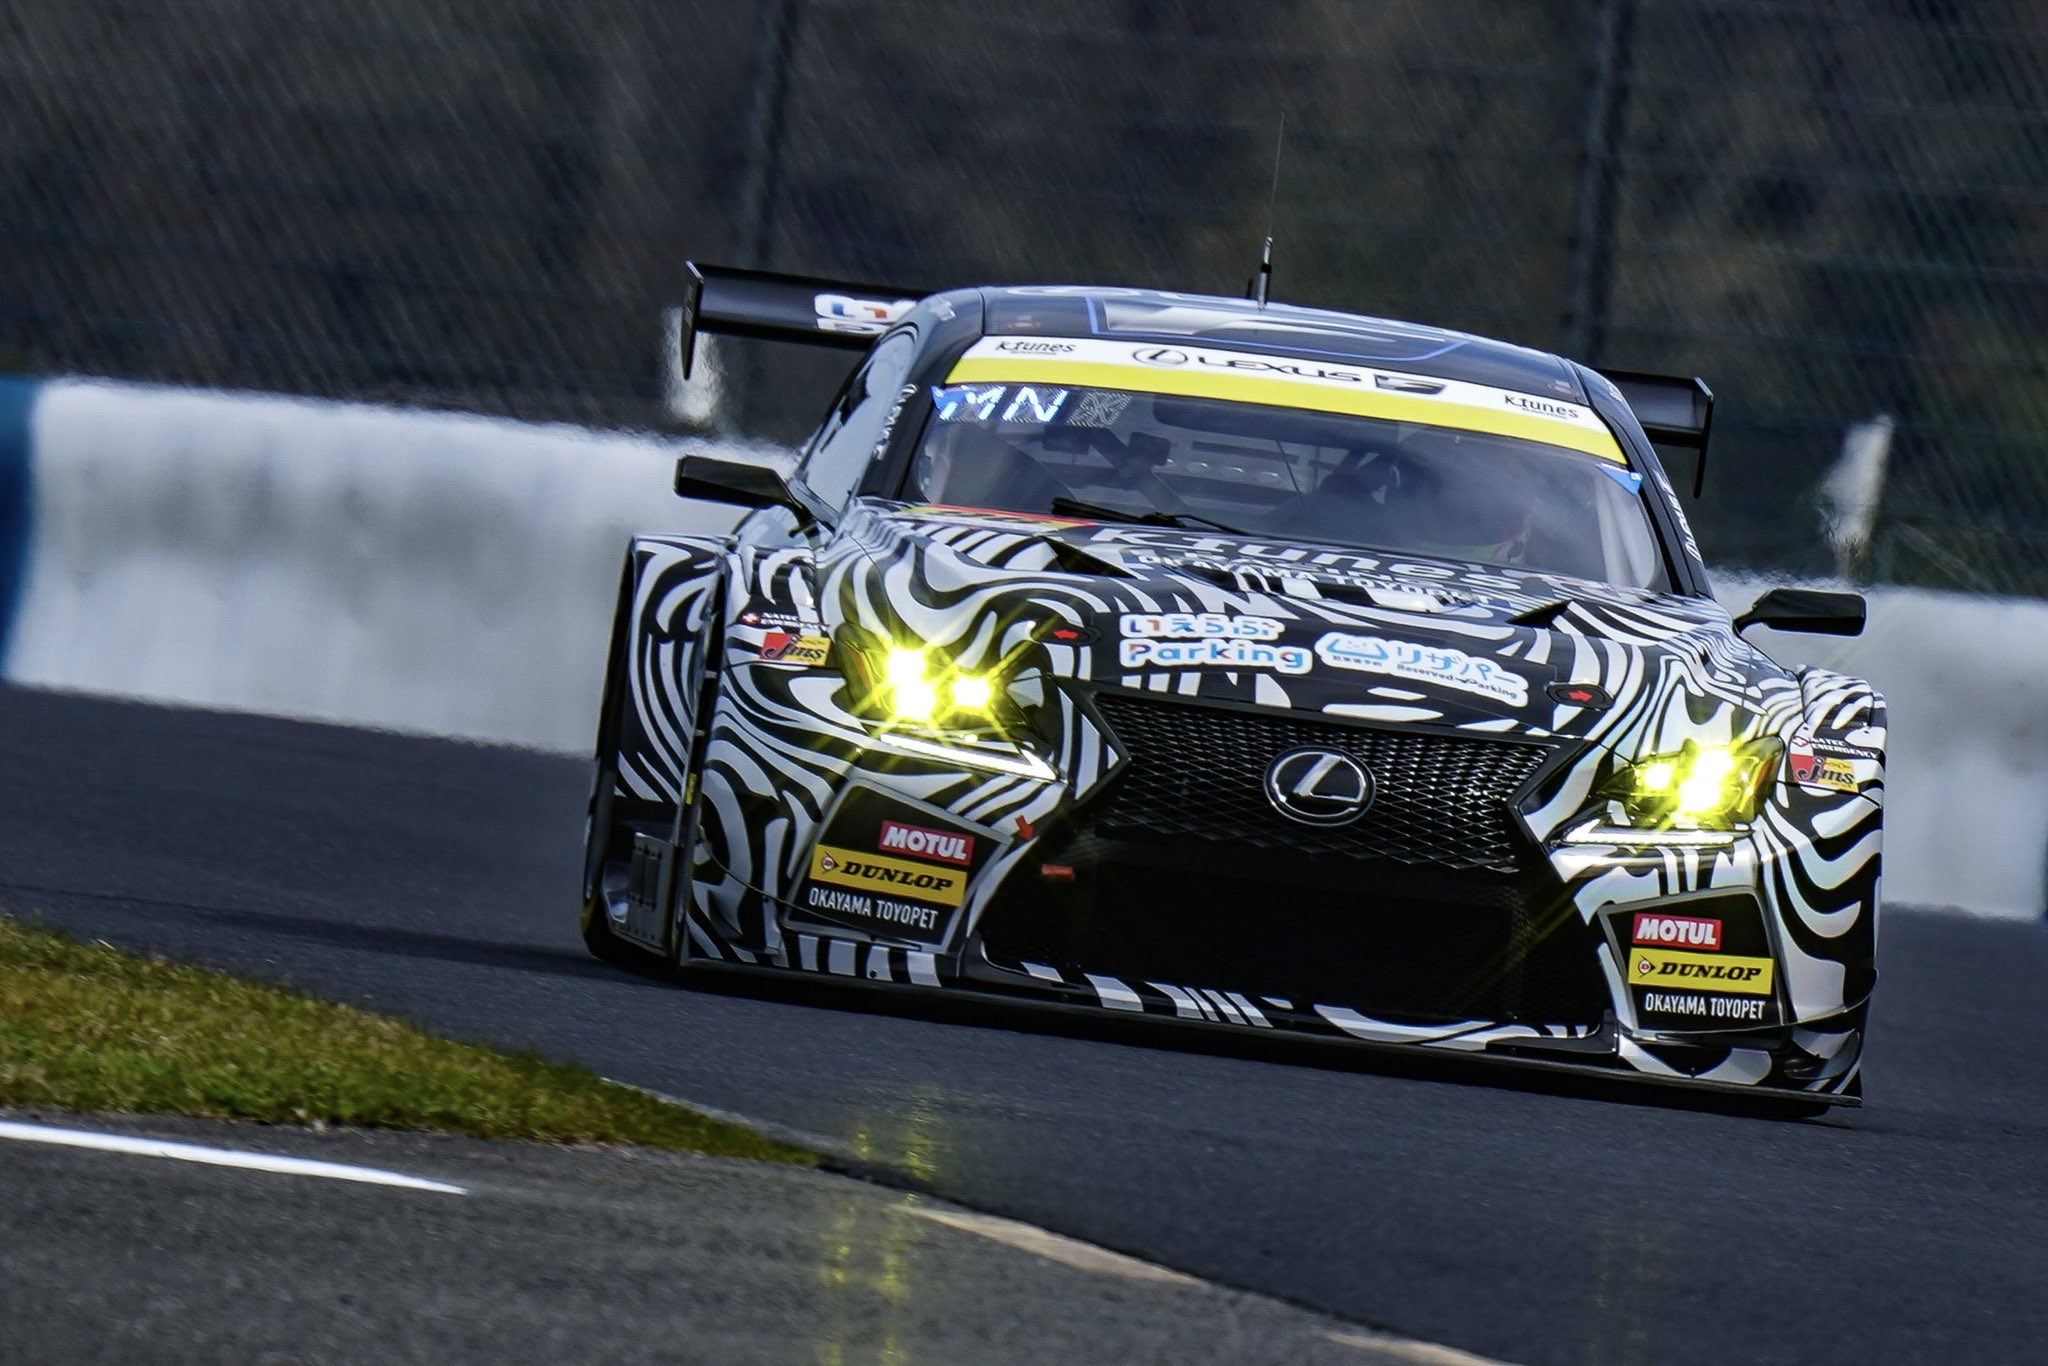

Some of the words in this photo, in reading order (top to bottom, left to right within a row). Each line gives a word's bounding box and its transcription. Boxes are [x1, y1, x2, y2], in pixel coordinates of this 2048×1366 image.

[1198, 356, 1362, 383] LEXUS
[1129, 643, 1303, 668] Parking
[1397, 664, 1454, 681] Reserved
[1457, 677, 1518, 699] Parking
[881, 825, 968, 860] MOTUL
[840, 860, 953, 891] DUNLOP
[808, 887, 873, 917] OKAYAMA
[876, 899, 939, 930] TOYOPET
[1635, 918, 1717, 945] MOTUL
[1657, 962, 1762, 981] DUNLOP
[1645, 993, 1706, 1016] OKAYAMA
[1710, 997, 1766, 1019] TOYOPET
